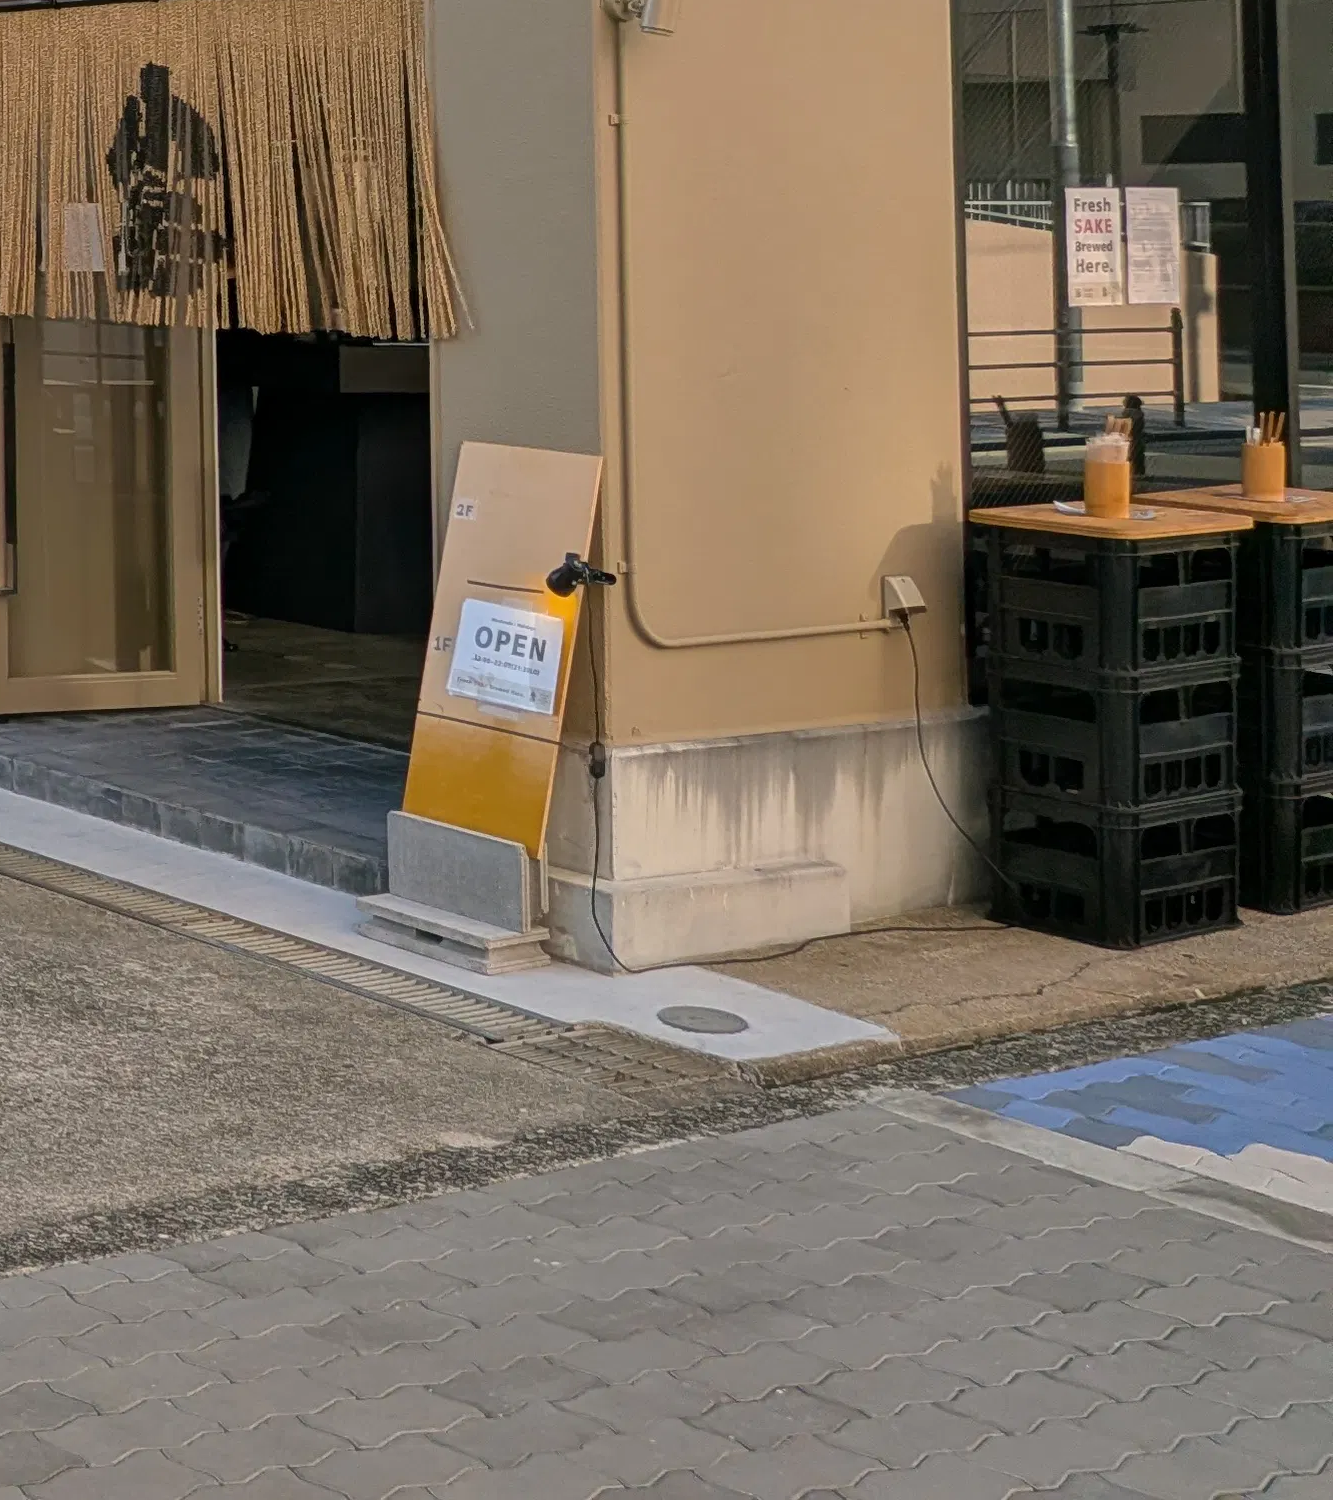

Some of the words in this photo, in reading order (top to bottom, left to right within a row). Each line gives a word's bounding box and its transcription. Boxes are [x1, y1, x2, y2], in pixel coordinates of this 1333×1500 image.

[1073, 198, 1112, 212] Fresh
[1074, 219, 1113, 234] SAKE
[1075, 240, 1113, 252] Brewed
[1076, 258, 1115, 273] Here.
[456, 503, 474, 517] 2F
[434, 636, 453, 652] 1F
[474, 626, 547, 663] OPEN
